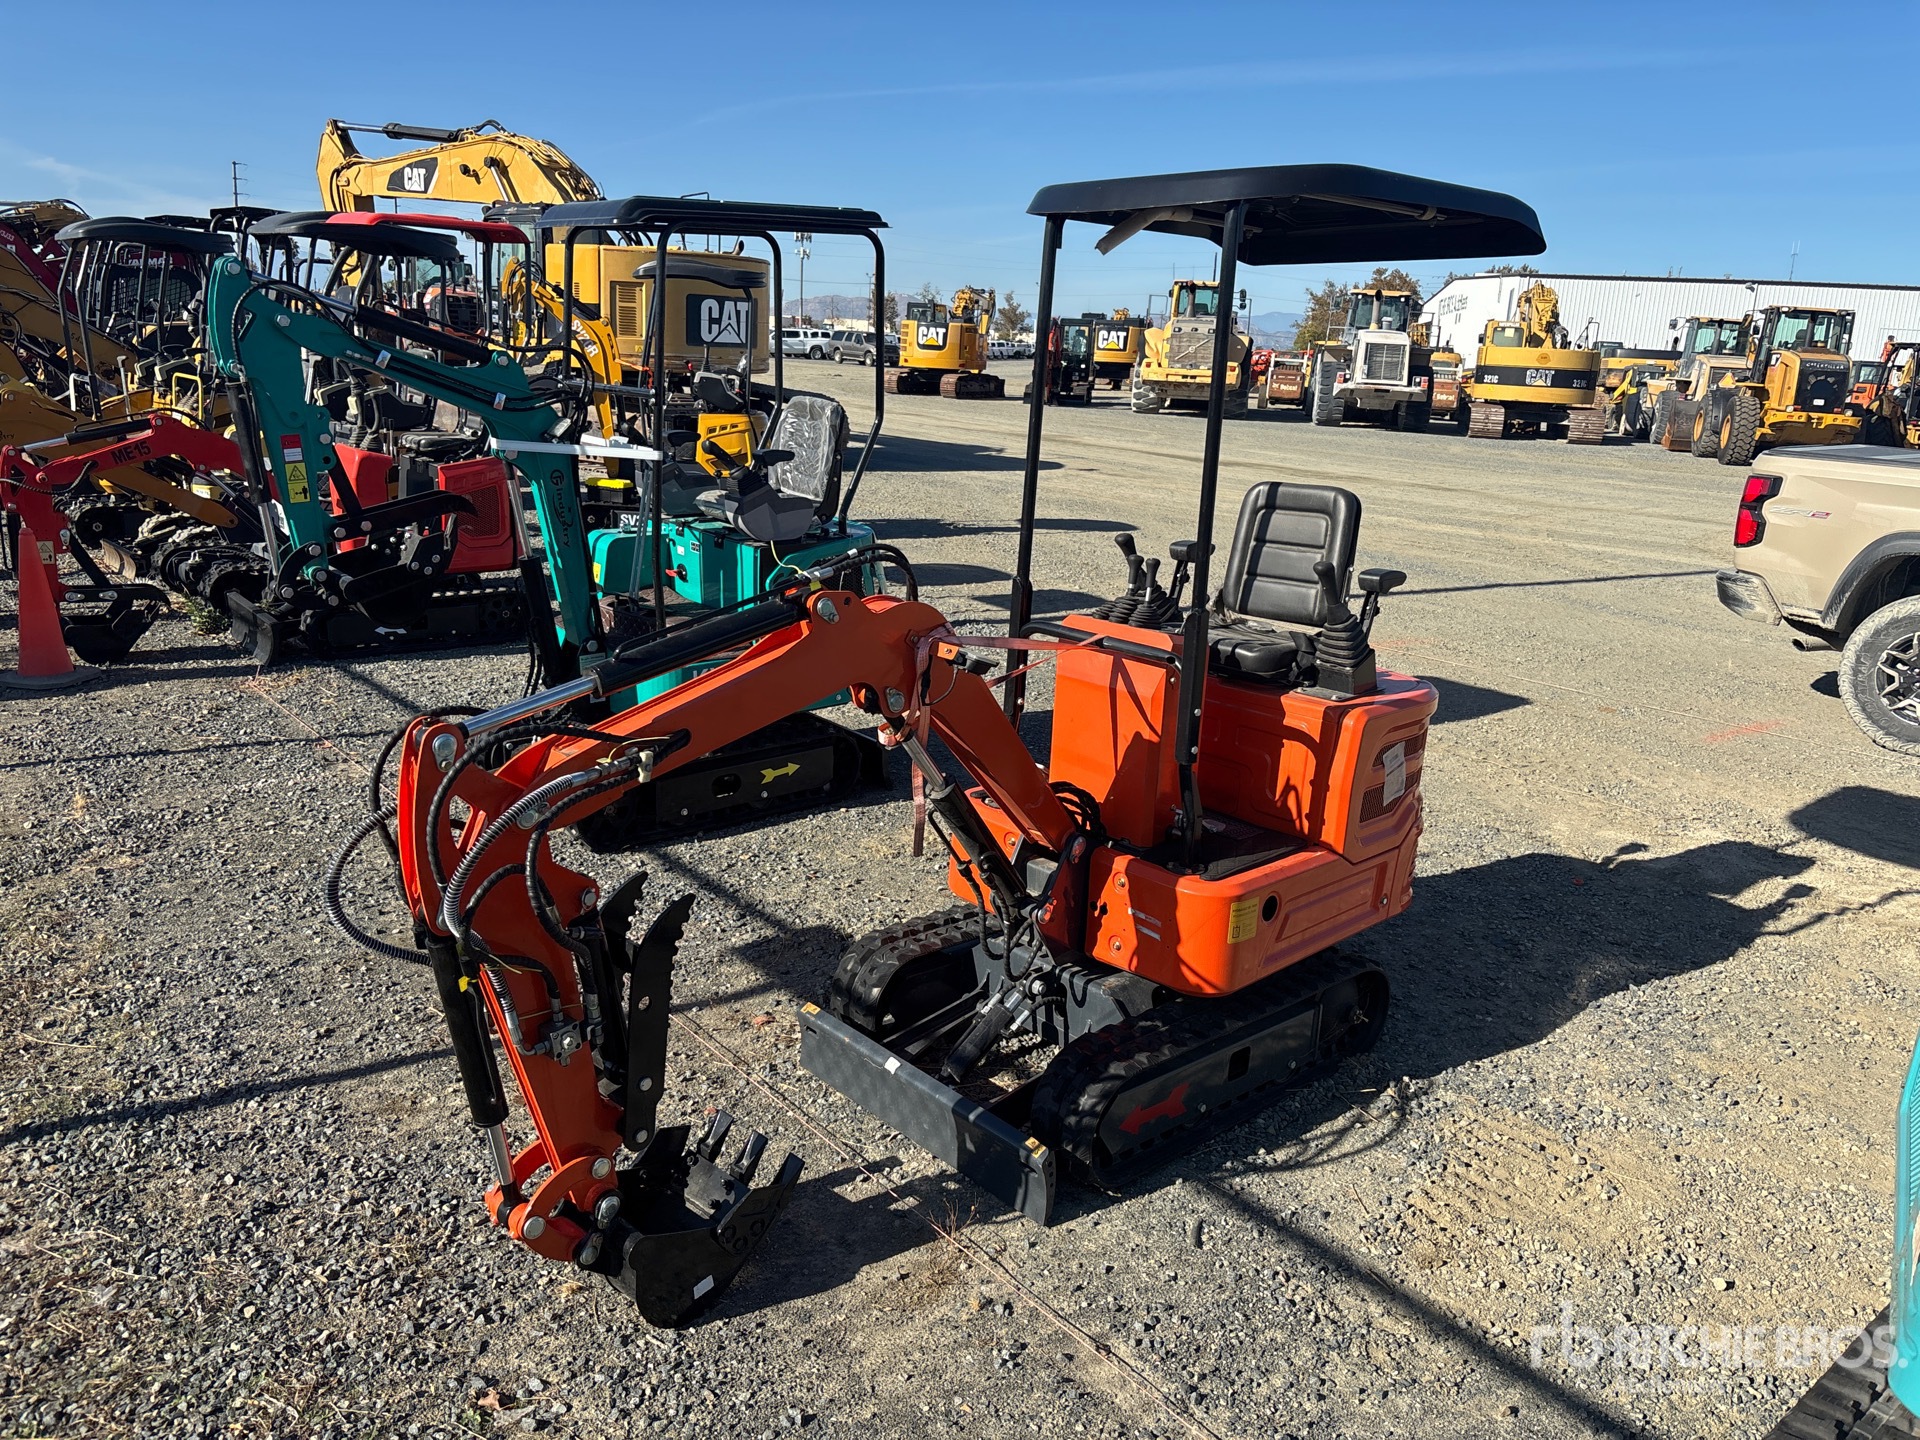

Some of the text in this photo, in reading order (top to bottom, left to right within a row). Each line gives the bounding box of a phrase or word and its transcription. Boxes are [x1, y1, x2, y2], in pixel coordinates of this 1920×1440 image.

[404, 167, 426, 191] CAT
[700, 298, 749, 343] CAT
[918, 326, 947, 346] CAT
[1098, 330, 1127, 349] CAT
[1280, 383, 1298, 391] Bobcat
[1483, 374, 1499, 383] 321C
[1525, 369, 1555, 386] CAT
[1436, 393, 1455, 401] Bobcat
[110, 440, 152, 465] ME15
